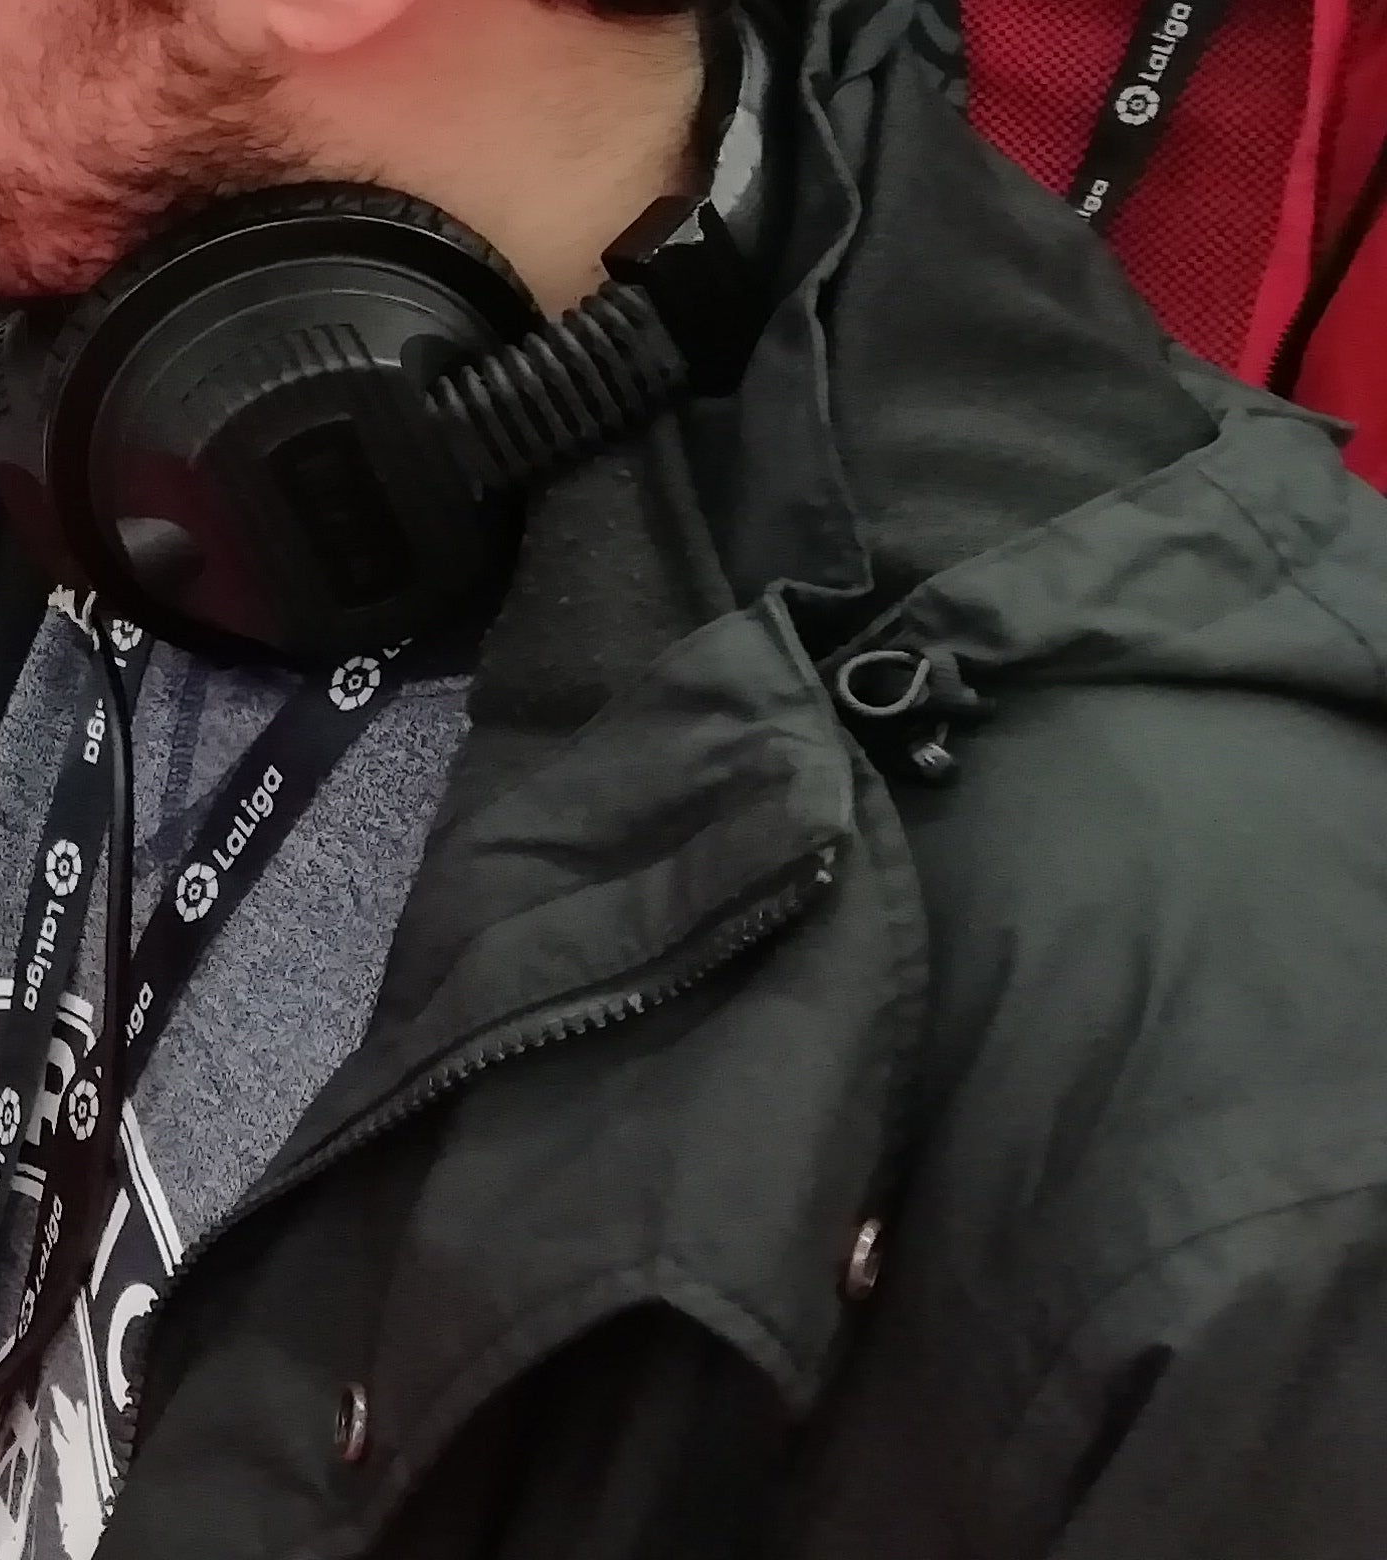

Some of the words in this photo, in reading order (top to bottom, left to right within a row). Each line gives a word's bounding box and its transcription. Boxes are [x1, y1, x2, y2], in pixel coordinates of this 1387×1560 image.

[1137, 2, 1193, 84] LaLiga
[212, 763, 284, 873] LaLiga
[23, 898, 65, 1012] LaLiga
[35, 1194, 63, 1295] LaLiga
